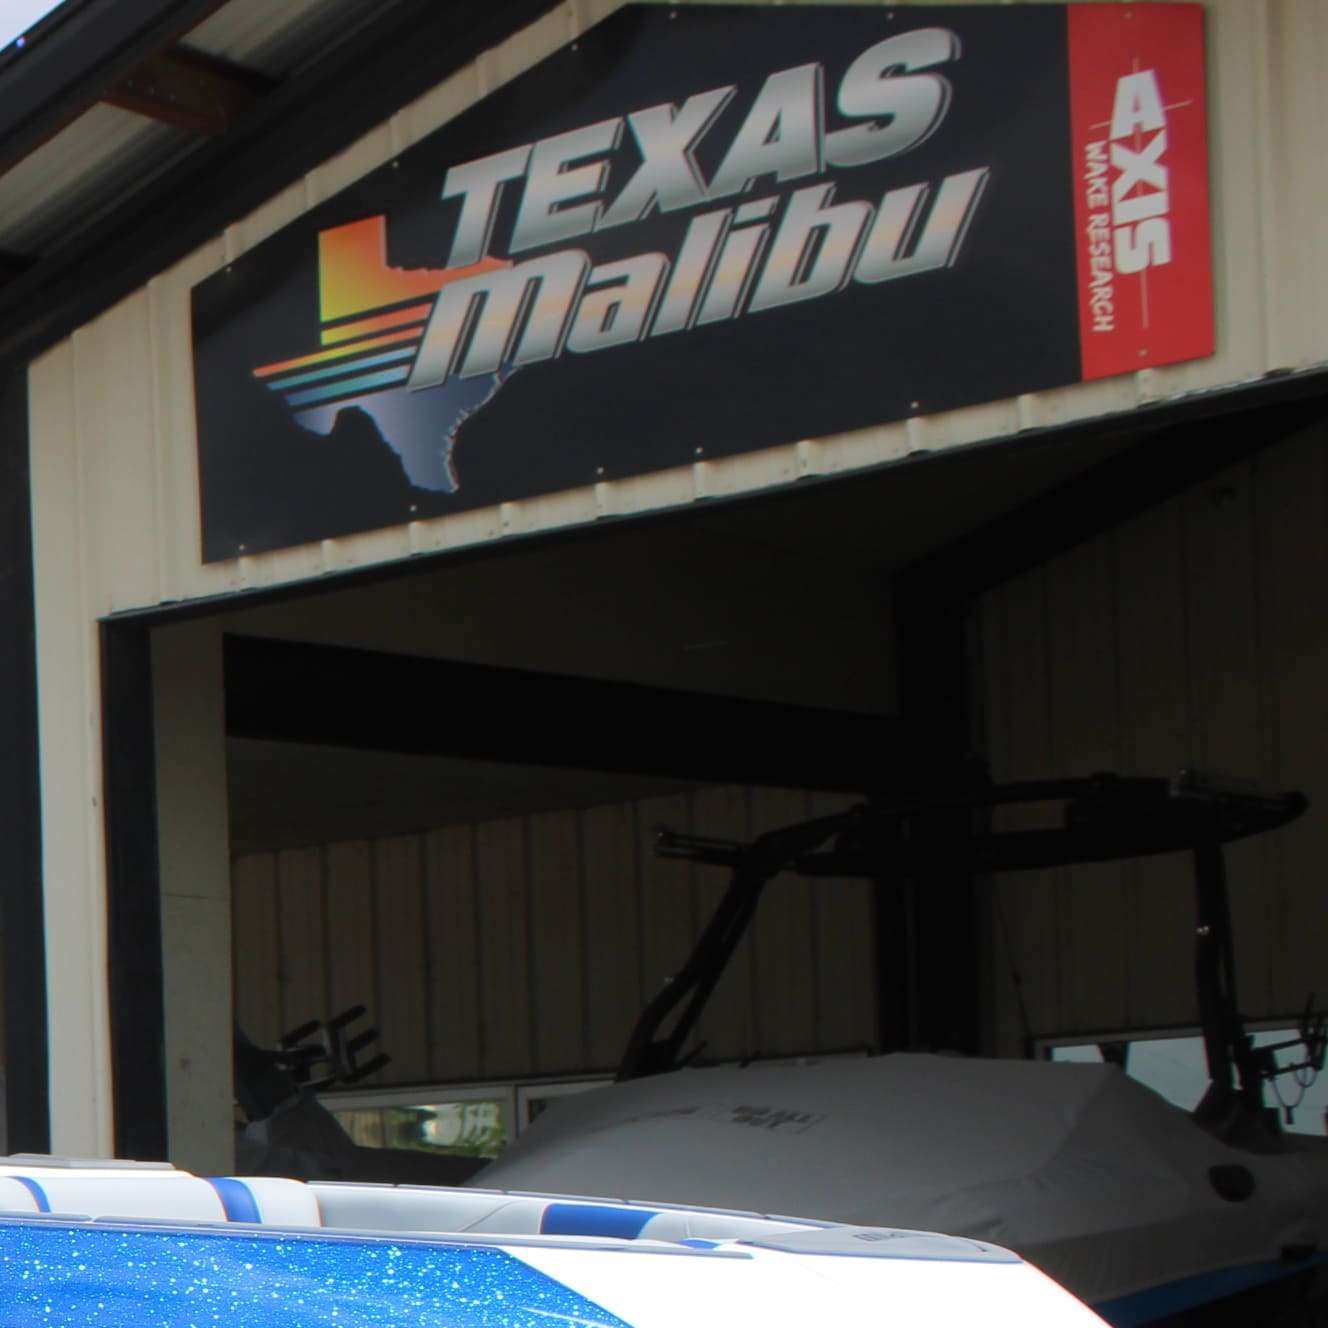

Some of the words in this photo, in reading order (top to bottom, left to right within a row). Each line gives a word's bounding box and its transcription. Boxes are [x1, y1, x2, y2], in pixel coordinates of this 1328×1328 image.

[441, 28, 962, 268] TEXAS
[1084, 140, 1110, 209] WAKE
[1109, 68, 1172, 275] AXIS
[406, 165, 991, 392] Malibu
[1086, 213, 1115, 332] RESEARCH
